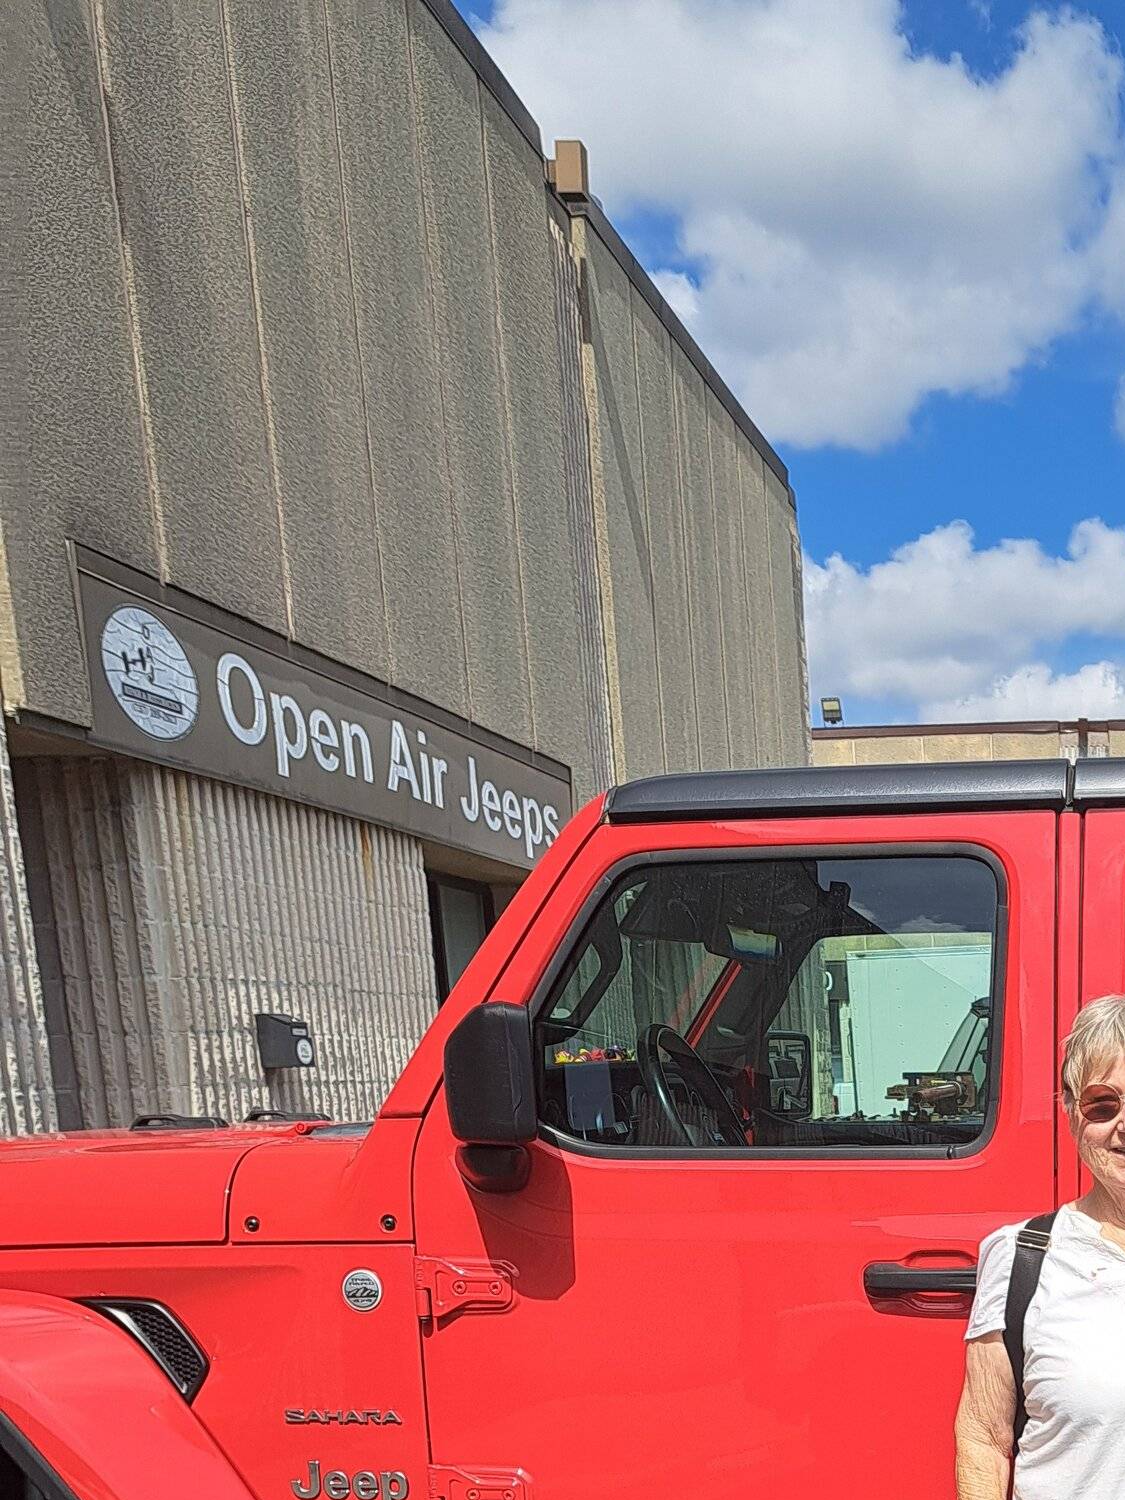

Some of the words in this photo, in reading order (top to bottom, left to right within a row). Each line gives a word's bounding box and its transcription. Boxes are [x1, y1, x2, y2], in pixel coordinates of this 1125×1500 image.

[217, 653, 374, 784] Open
[387, 720, 448, 809] Air
[460, 756, 560, 859] Jeeps
[285, 1408, 402, 1425] SAHARA
